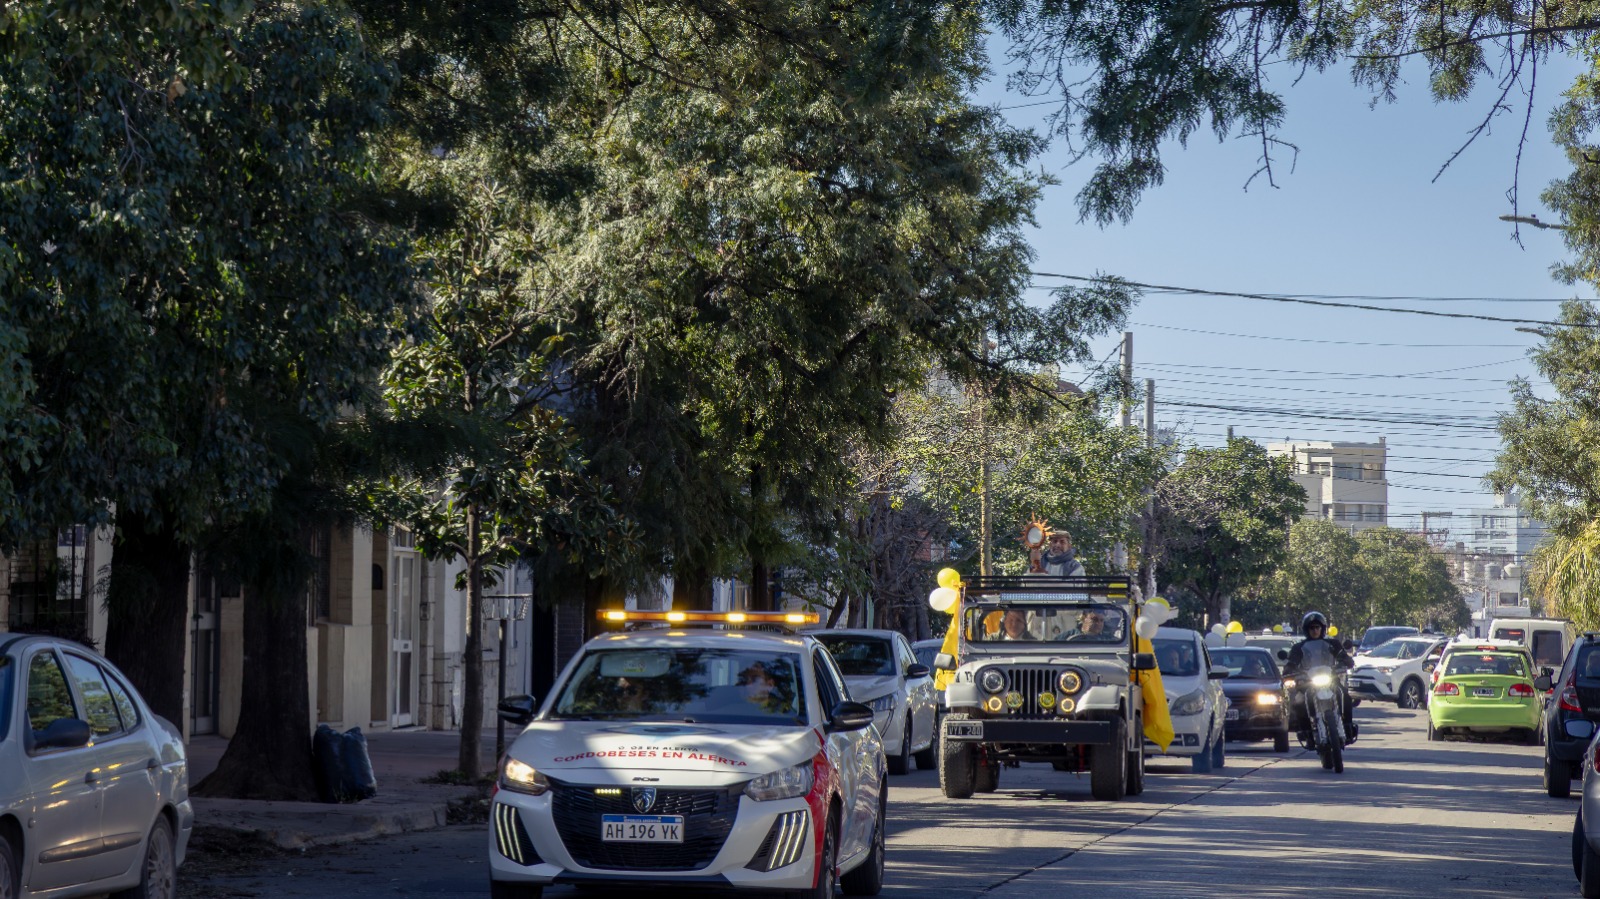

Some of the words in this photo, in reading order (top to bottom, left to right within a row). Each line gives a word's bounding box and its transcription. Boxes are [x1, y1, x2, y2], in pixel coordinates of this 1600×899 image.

[553, 750, 657, 763] CORDOBESES
[662, 751, 683, 759] EN
[688, 752, 747, 767] ALERTA
[605, 824, 624, 839] AH
[628, 824, 656, 839] 196
[661, 825, 679, 840] YK
